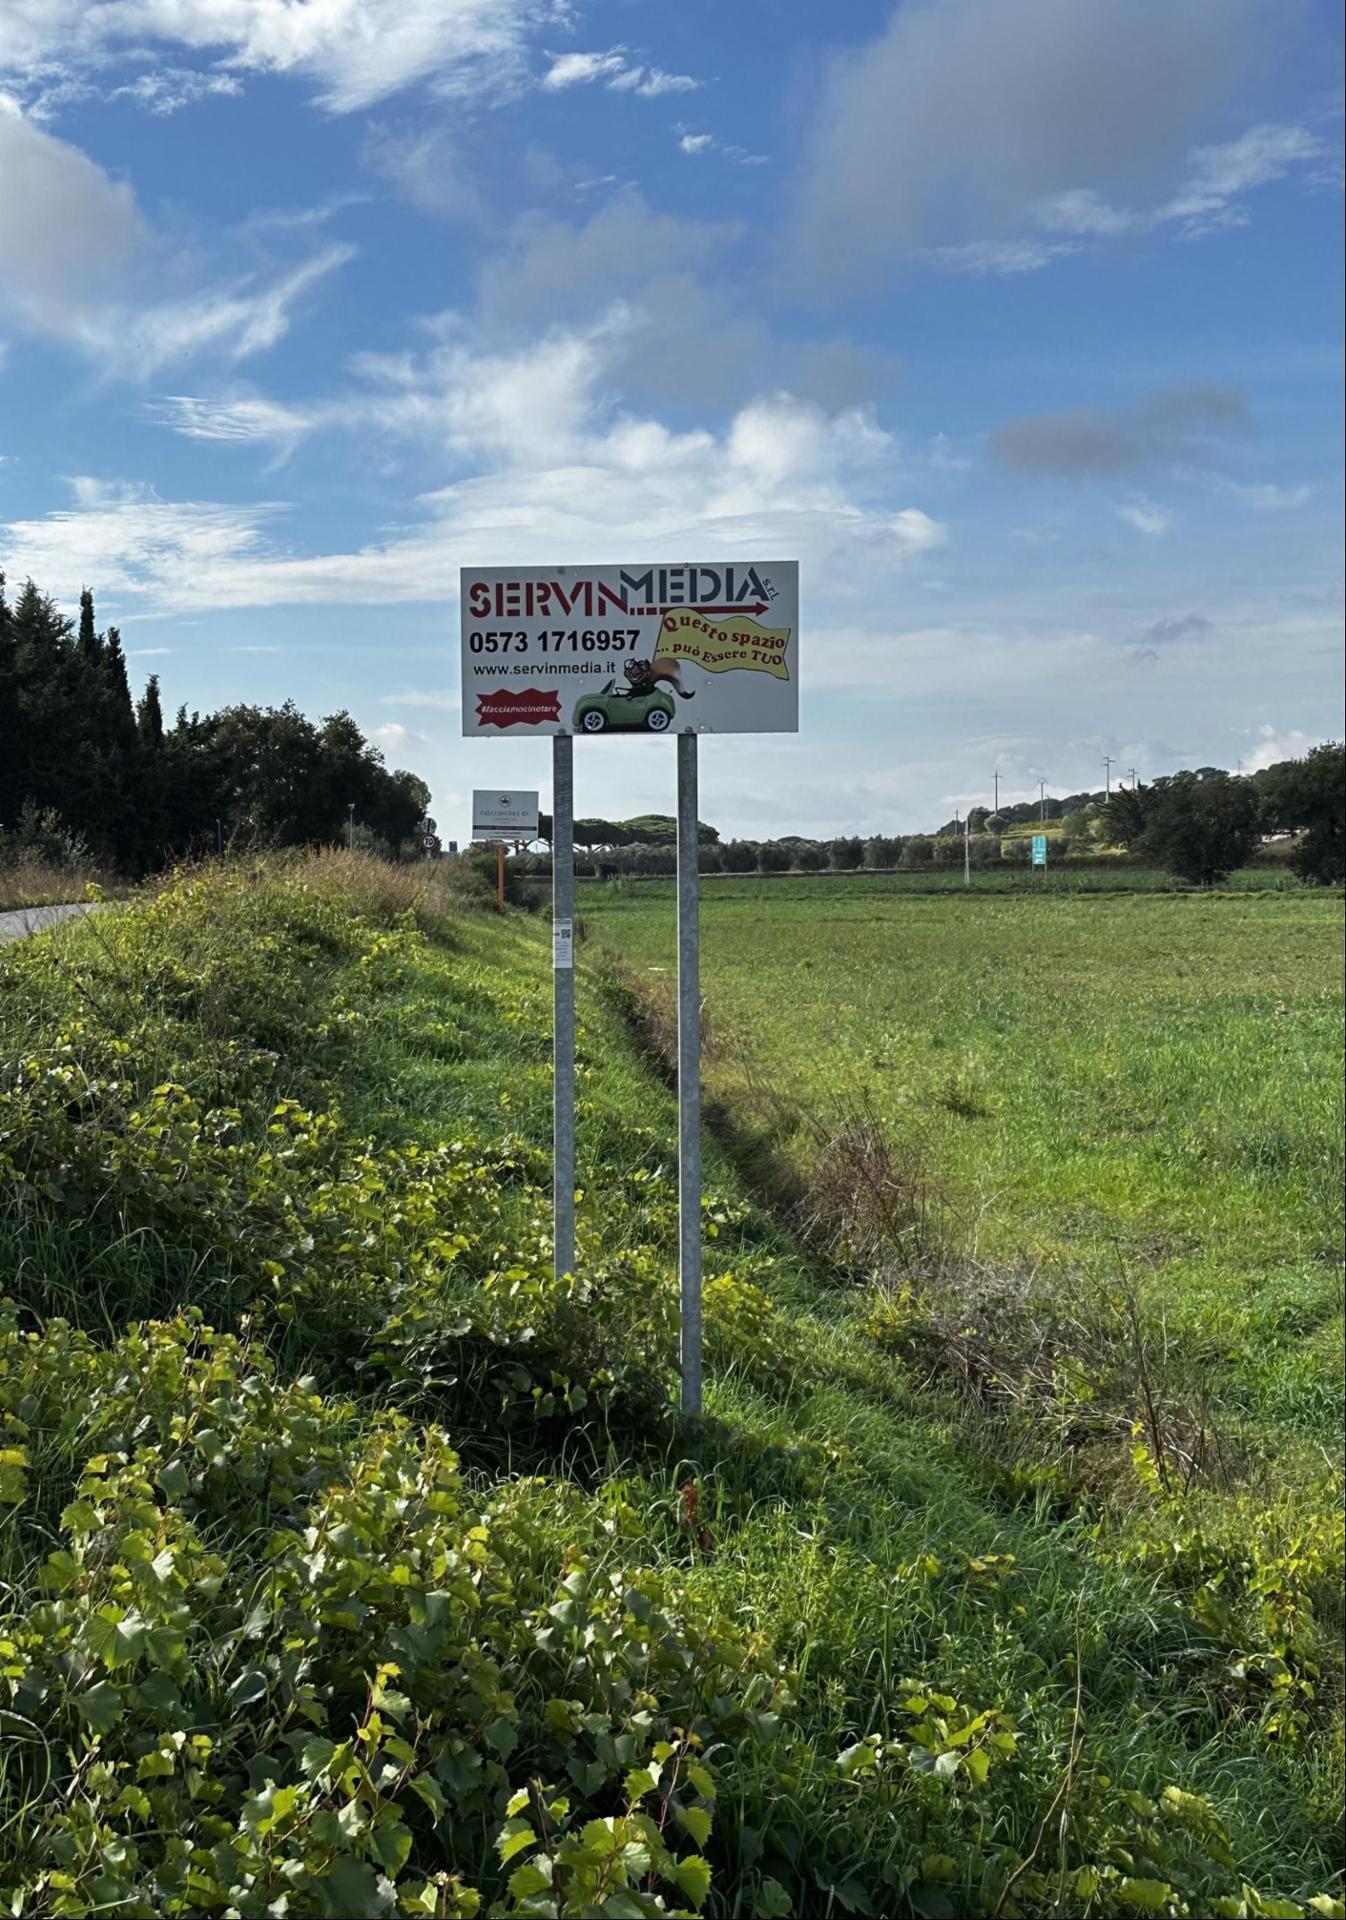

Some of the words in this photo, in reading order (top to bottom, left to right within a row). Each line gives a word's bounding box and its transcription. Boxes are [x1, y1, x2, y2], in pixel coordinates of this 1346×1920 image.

[469, 566, 770, 618] SERVINMEDIA
[469, 631, 528, 653] 0573
[537, 629, 641, 652] 1716957
[664, 617, 728, 641] Questo
[731, 631, 785, 649] spazio
[701, 650, 747, 663] Essere
[751, 650, 783, 666] TUO
[473, 661, 616, 676] www.servinmedia.it
[481, 705, 558, 714] #facciamocinotare
